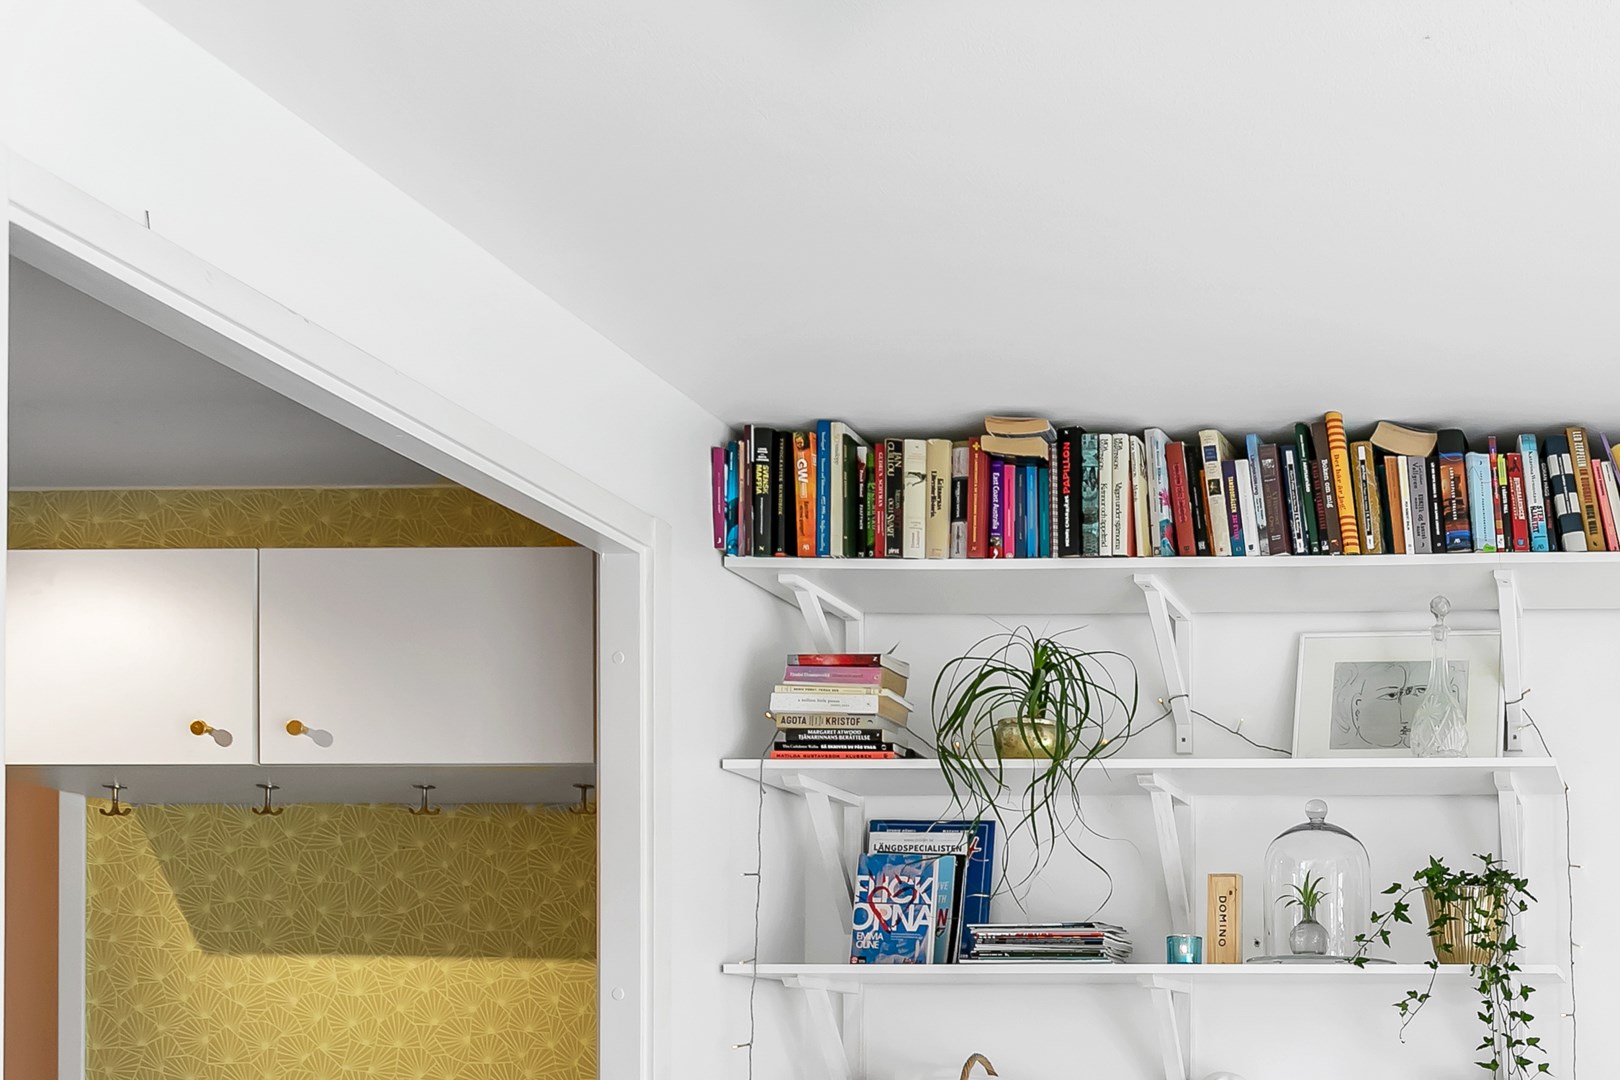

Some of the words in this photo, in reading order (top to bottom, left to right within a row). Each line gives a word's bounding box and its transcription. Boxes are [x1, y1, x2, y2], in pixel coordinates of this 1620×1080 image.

[1573, 431, 1583, 442] LED
[1527, 451, 1535, 475] Katarina
[1574, 442, 1587, 468] ZEPPELIN
[797, 458, 809, 482] GW
[992, 472, 1000, 485] East
[1063, 442, 1071, 494] PAPILLON
[1321, 459, 1330, 482] Boken
[1411, 462, 1419, 490] Vallgren
[1540, 462, 1548, 481] GÖRAN
[992, 486, 1000, 503] Coast
[1325, 482, 1332, 494] om
[1338, 484, 1344, 495] är
[1326, 494, 1334, 509] mig
[886, 514, 895, 538] SVART
[992, 503, 1000, 529] Australia
[781, 716, 807, 725] AGOTA
[825, 716, 862, 726] KRISTOF
[873, 843, 962, 853] LÄNGDSPECIALISTEN
[856, 874, 934, 904] FLICK
[852, 904, 933, 932] ORNA
[1219, 896, 1227, 947] DOMINO
[856, 932, 884, 941] EMMA
